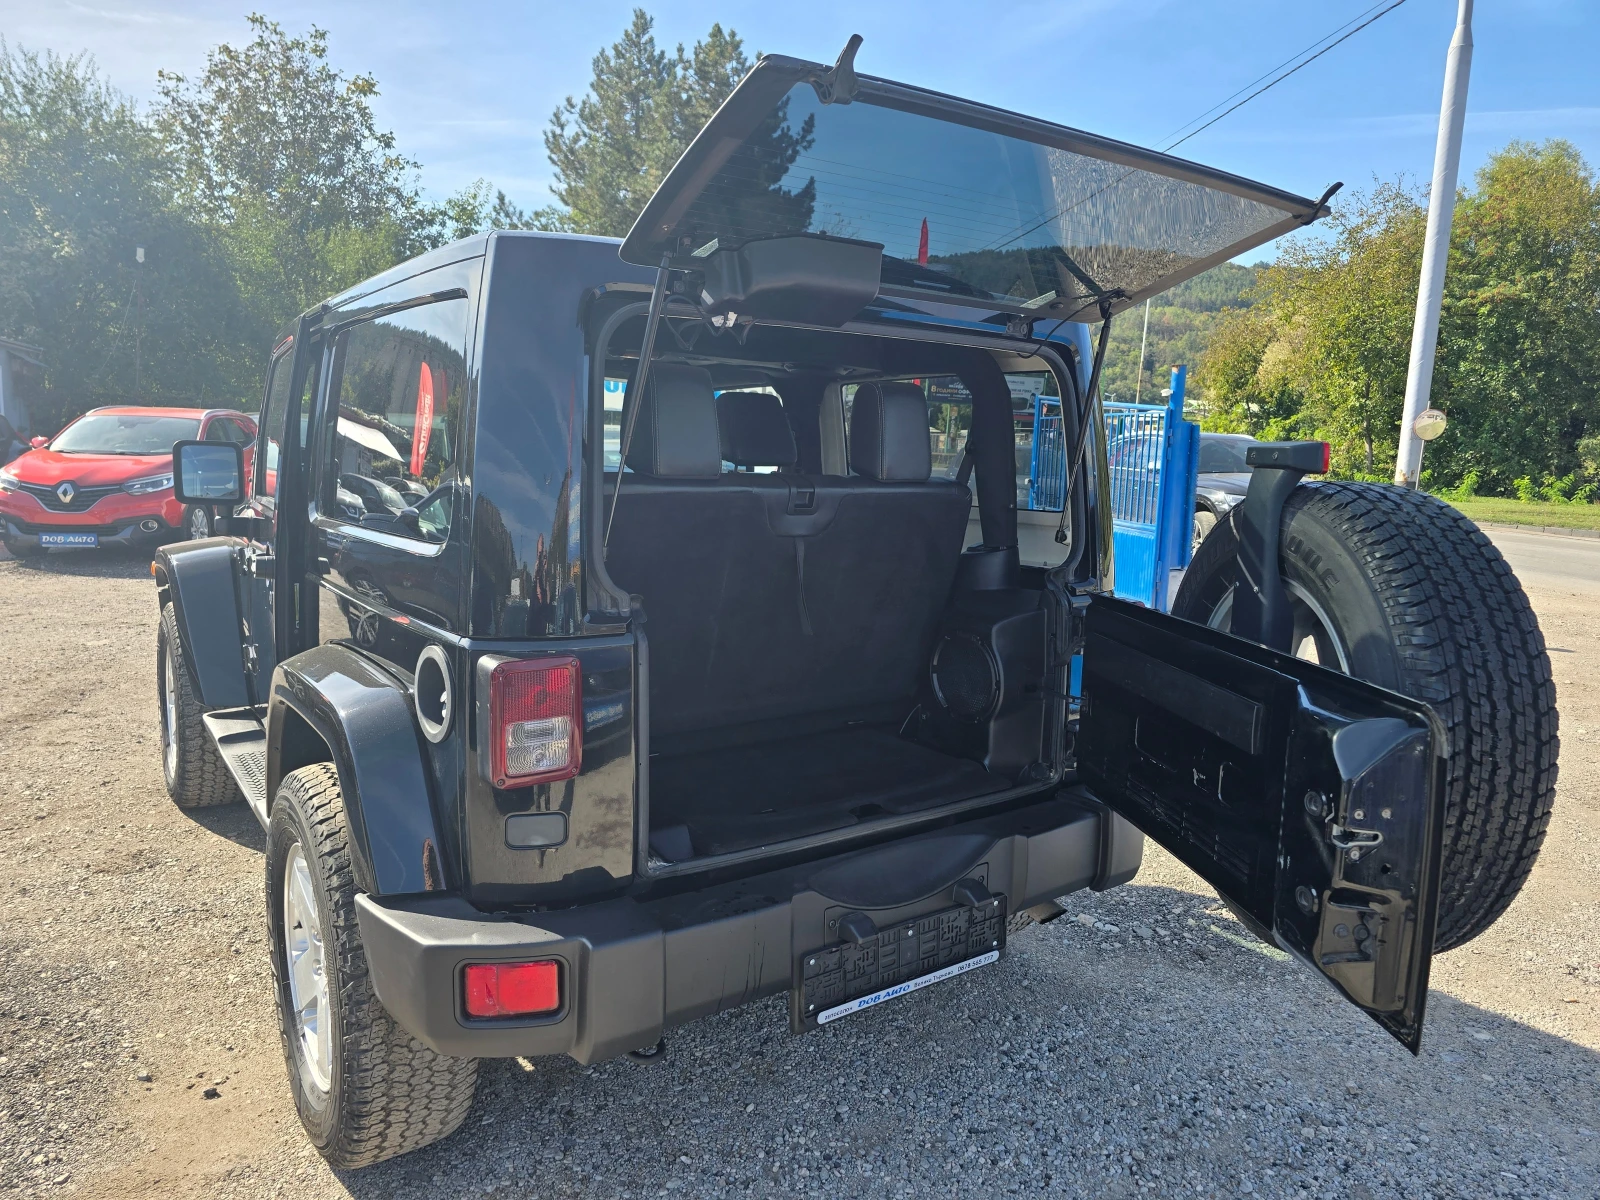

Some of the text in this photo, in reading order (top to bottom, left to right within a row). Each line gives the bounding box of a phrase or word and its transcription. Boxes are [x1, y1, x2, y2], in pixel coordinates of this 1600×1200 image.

[931, 385, 937, 393] 8
[42, 535, 64, 543] DOB
[857, 994, 881, 1008] DOB
[883, 984, 910, 1000] AUTO
[983, 954, 994, 963] 777
